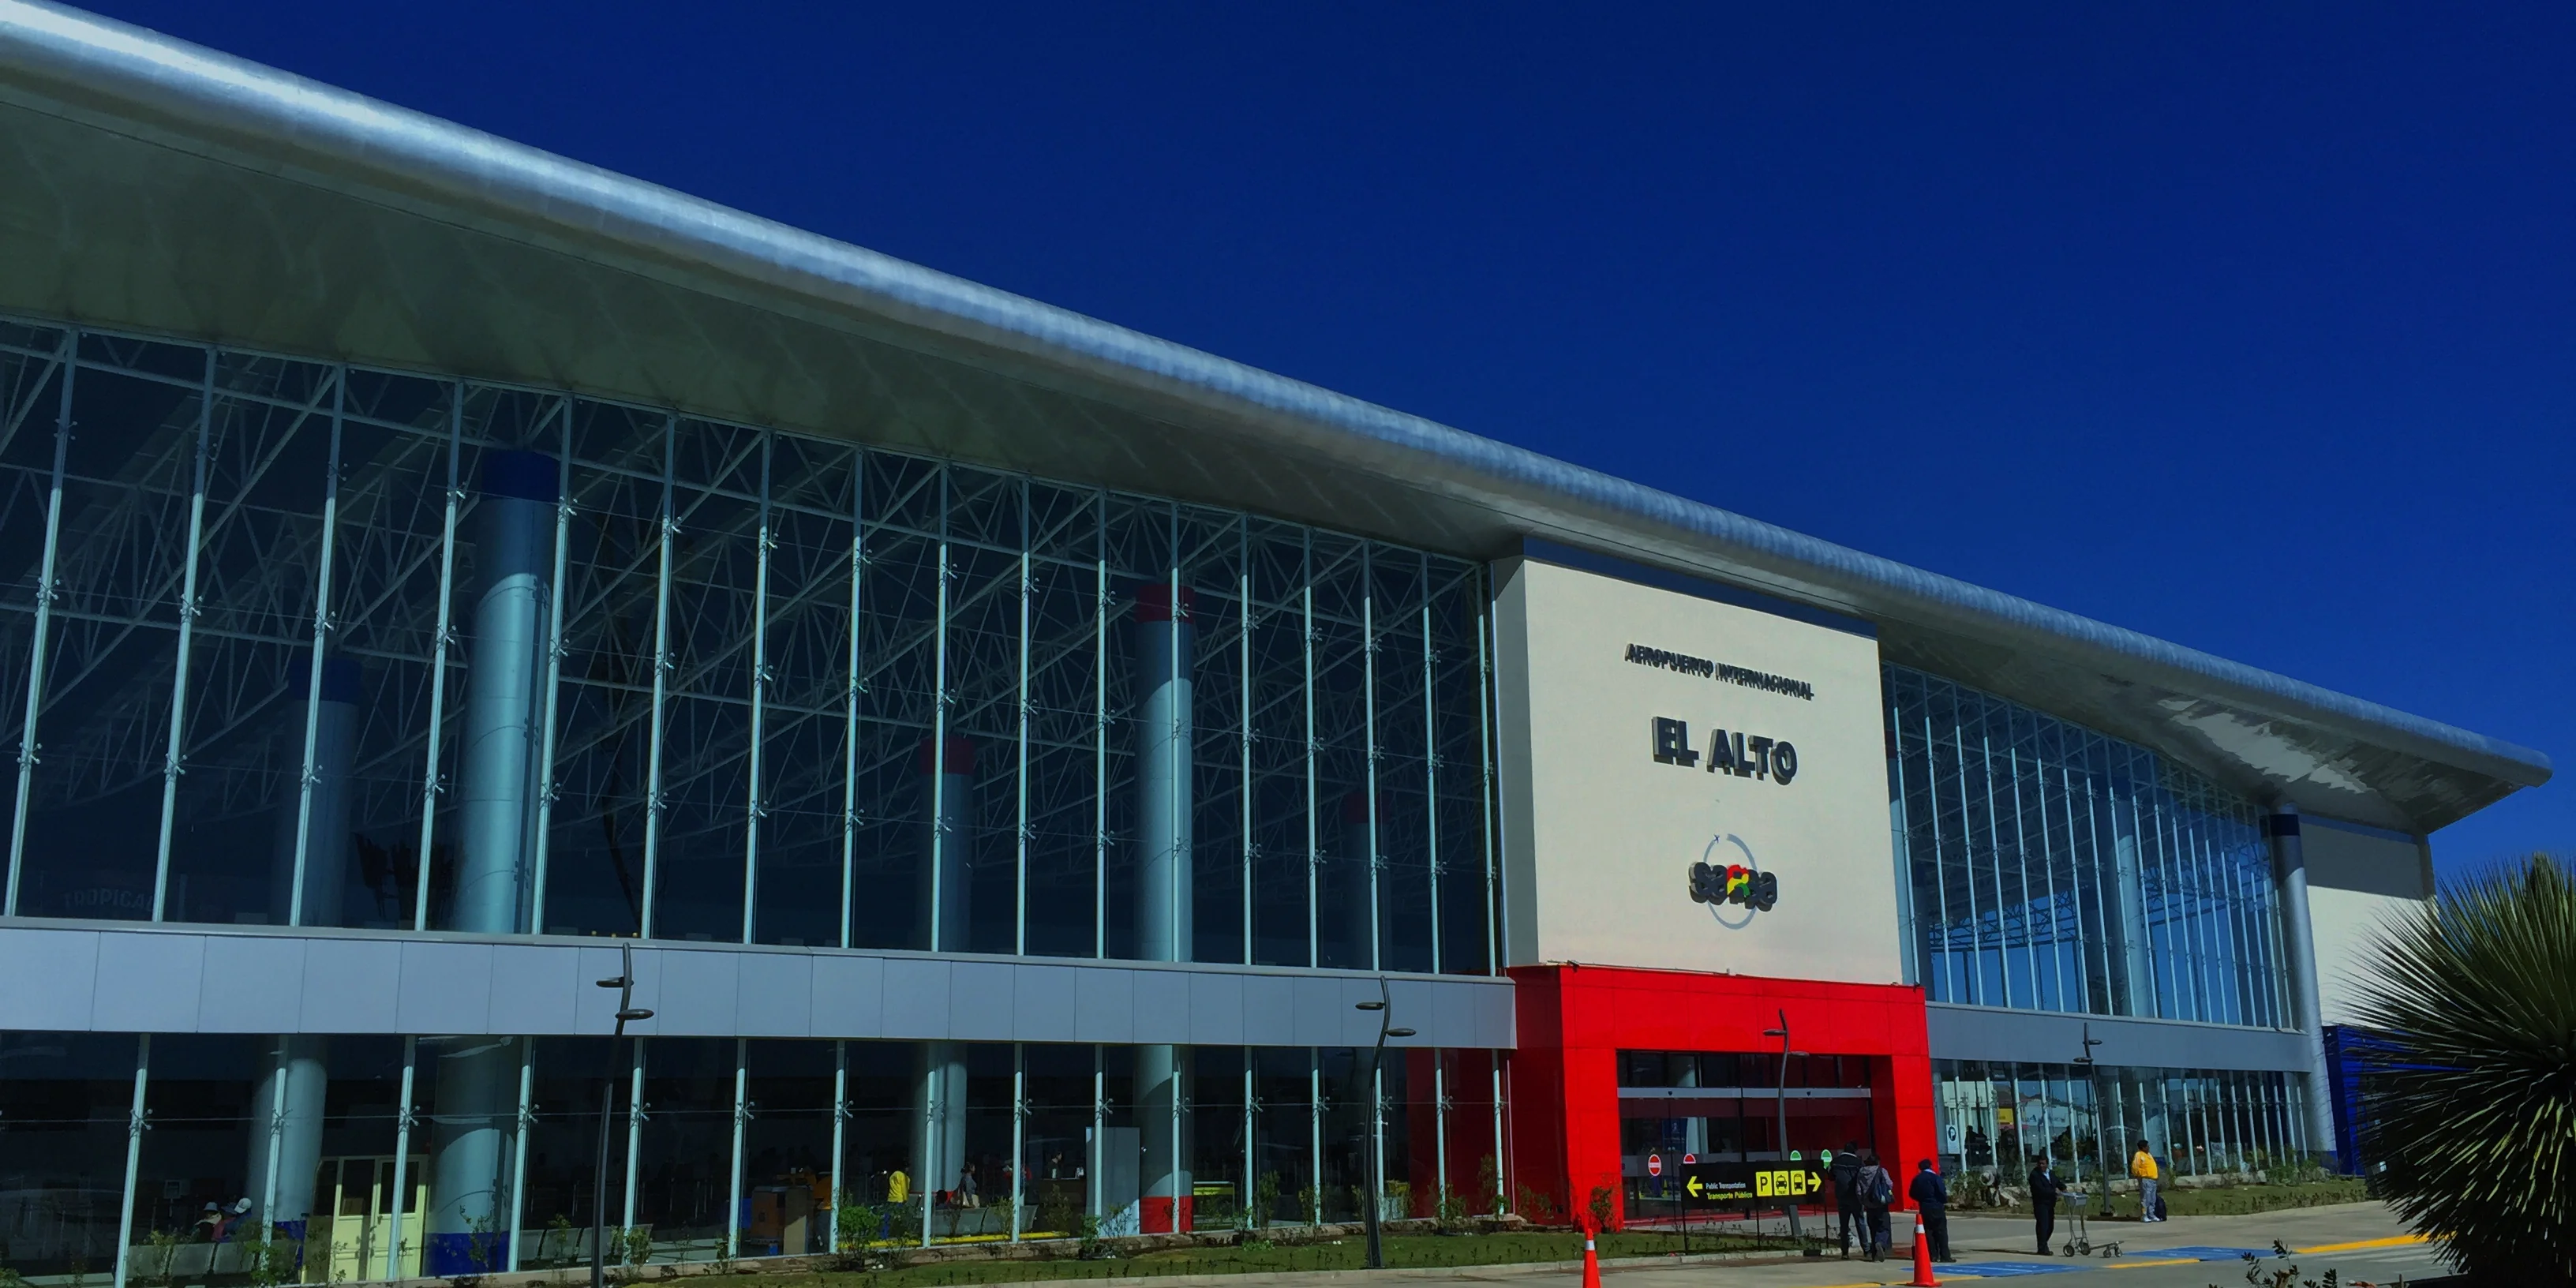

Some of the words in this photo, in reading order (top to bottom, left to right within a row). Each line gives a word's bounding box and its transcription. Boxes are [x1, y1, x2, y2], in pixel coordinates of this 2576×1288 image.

[1624, 643, 1714, 679] AEROPUERTO
[1715, 662, 1814, 701] INTERNACIONAL
[1652, 716, 1699, 768] EL
[1707, 728, 1798, 785] ALTO
[1706, 1192, 1733, 1200] Transporte
[1760, 1176, 1768, 1192] P
